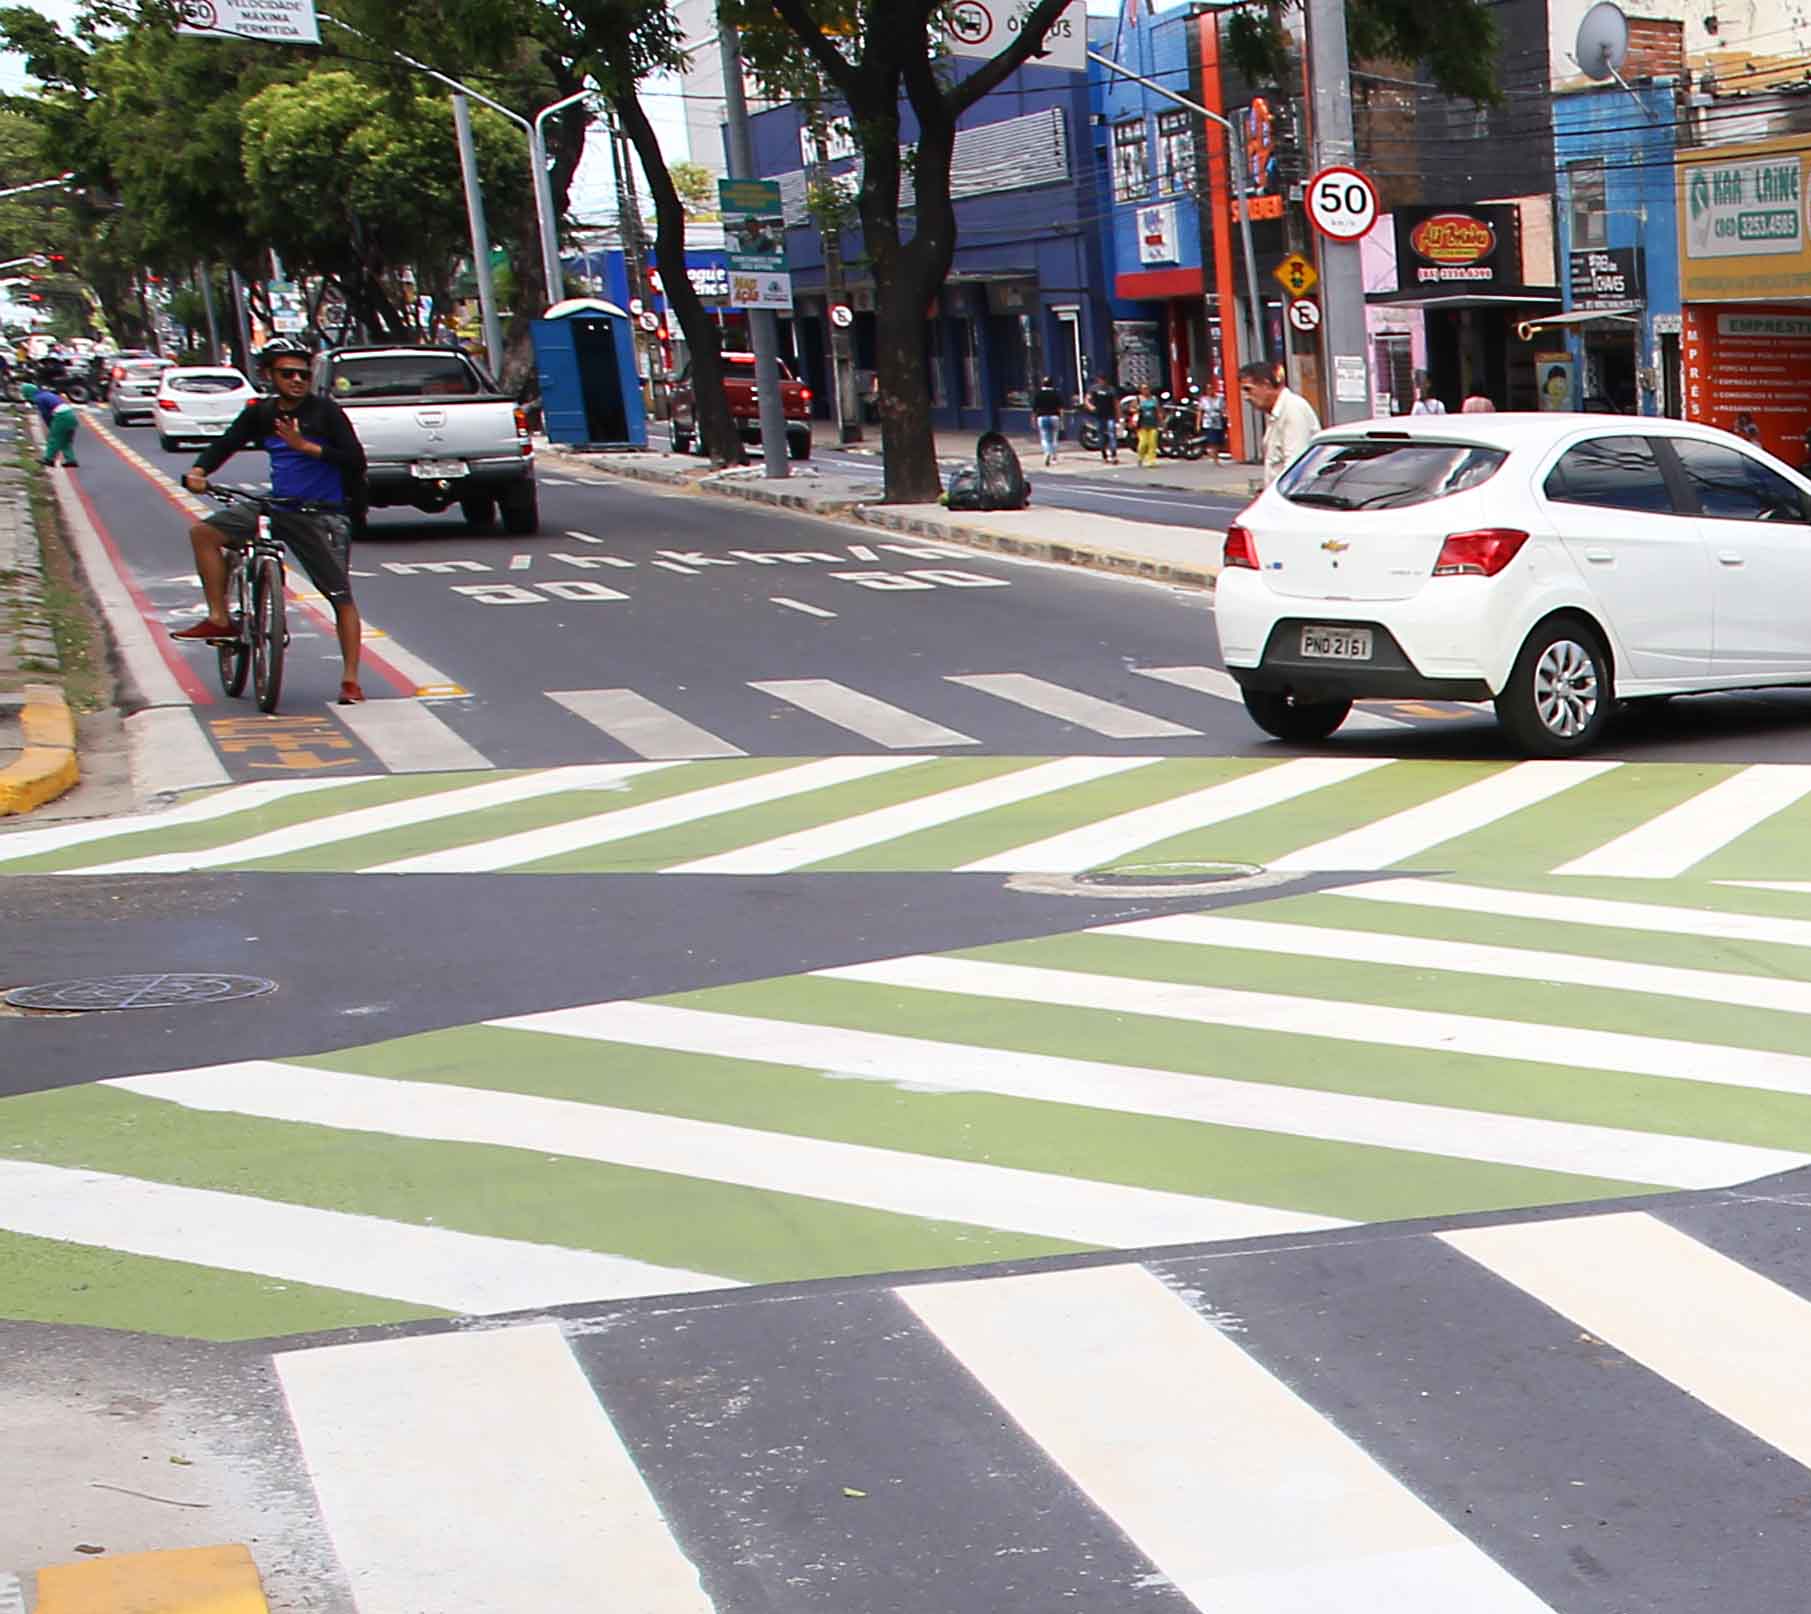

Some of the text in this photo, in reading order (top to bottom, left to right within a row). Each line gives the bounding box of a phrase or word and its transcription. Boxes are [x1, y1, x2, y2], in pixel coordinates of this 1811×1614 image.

[1320, 184, 1367, 213] 50
[829, 568, 1011, 590] 50
[451, 583, 631, 604] 50
